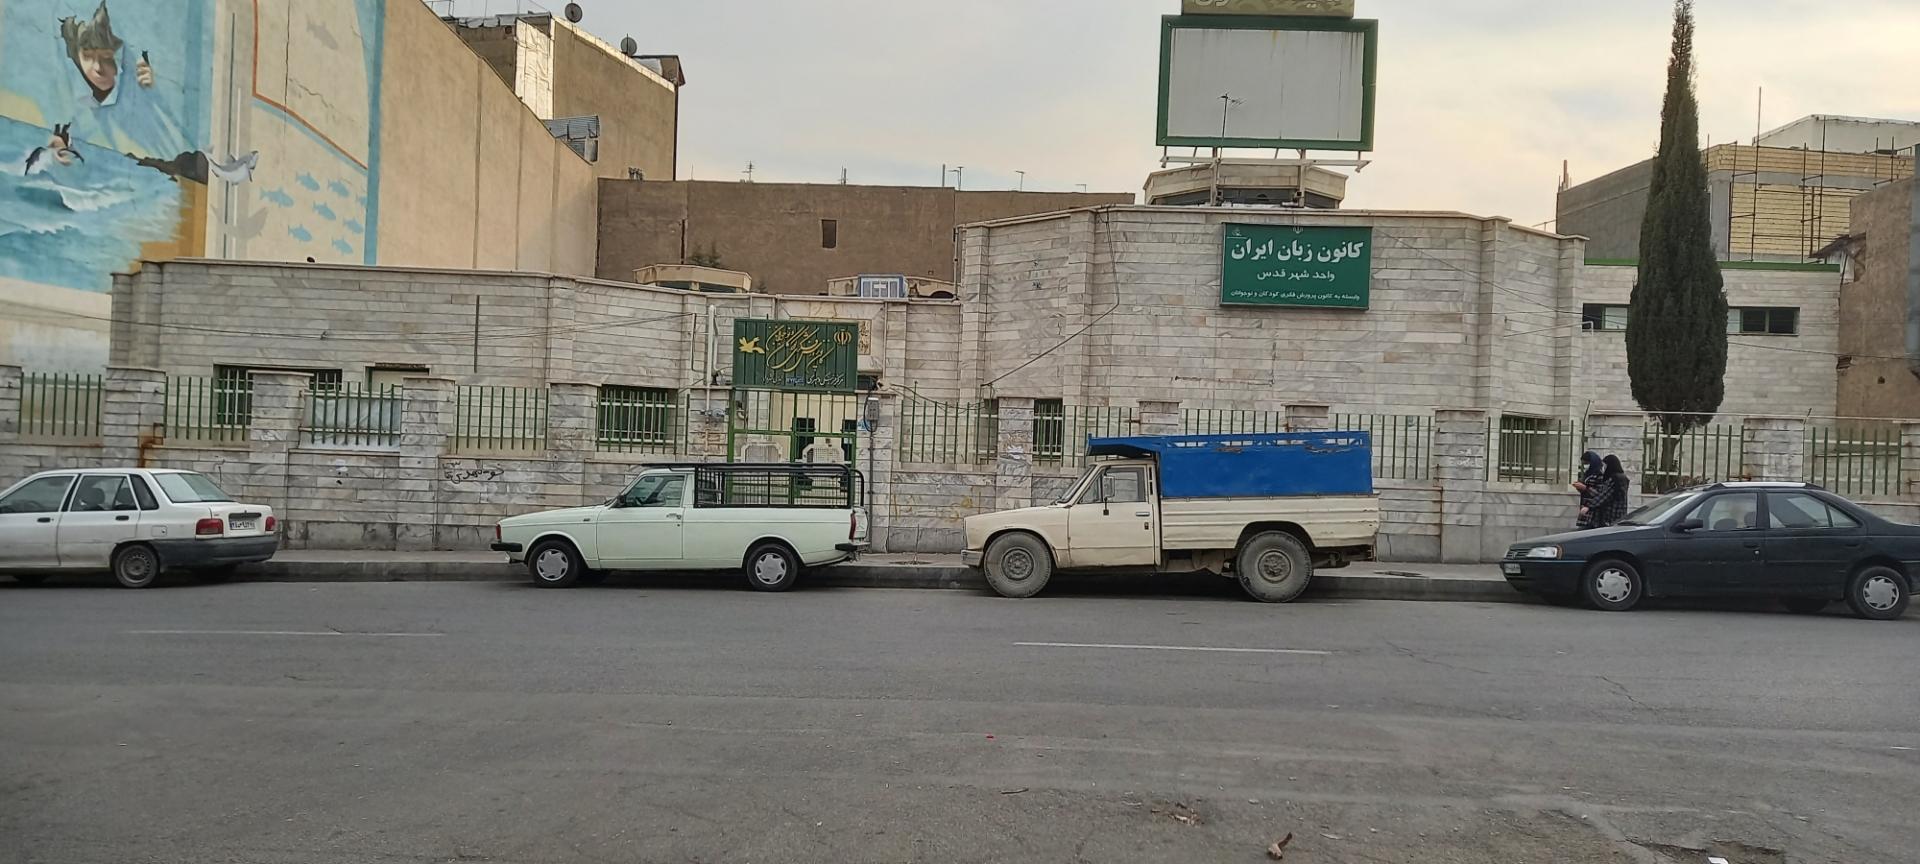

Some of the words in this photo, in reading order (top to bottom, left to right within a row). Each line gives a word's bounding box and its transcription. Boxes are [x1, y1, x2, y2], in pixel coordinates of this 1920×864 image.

[1231, 238, 1274, 260] ایران
[1277, 239, 1313, 262] زبان
[1317, 241, 1364, 263] کانون
[1256, 268, 1286, 280] قدس
[1288, 269, 1310, 280] شهر
[1312, 270, 1336, 282] واحد
[1230, 289, 1253, 297] نوجوانان
[1258, 289, 1280, 298] کودکان
[1280, 291, 1296, 299] فکری
[1296, 291, 1317, 301] پرورش
[1317, 292, 1333, 301] کانون
[1333, 293, 1341, 301] به
[1341, 293, 1360, 301] وابسته
